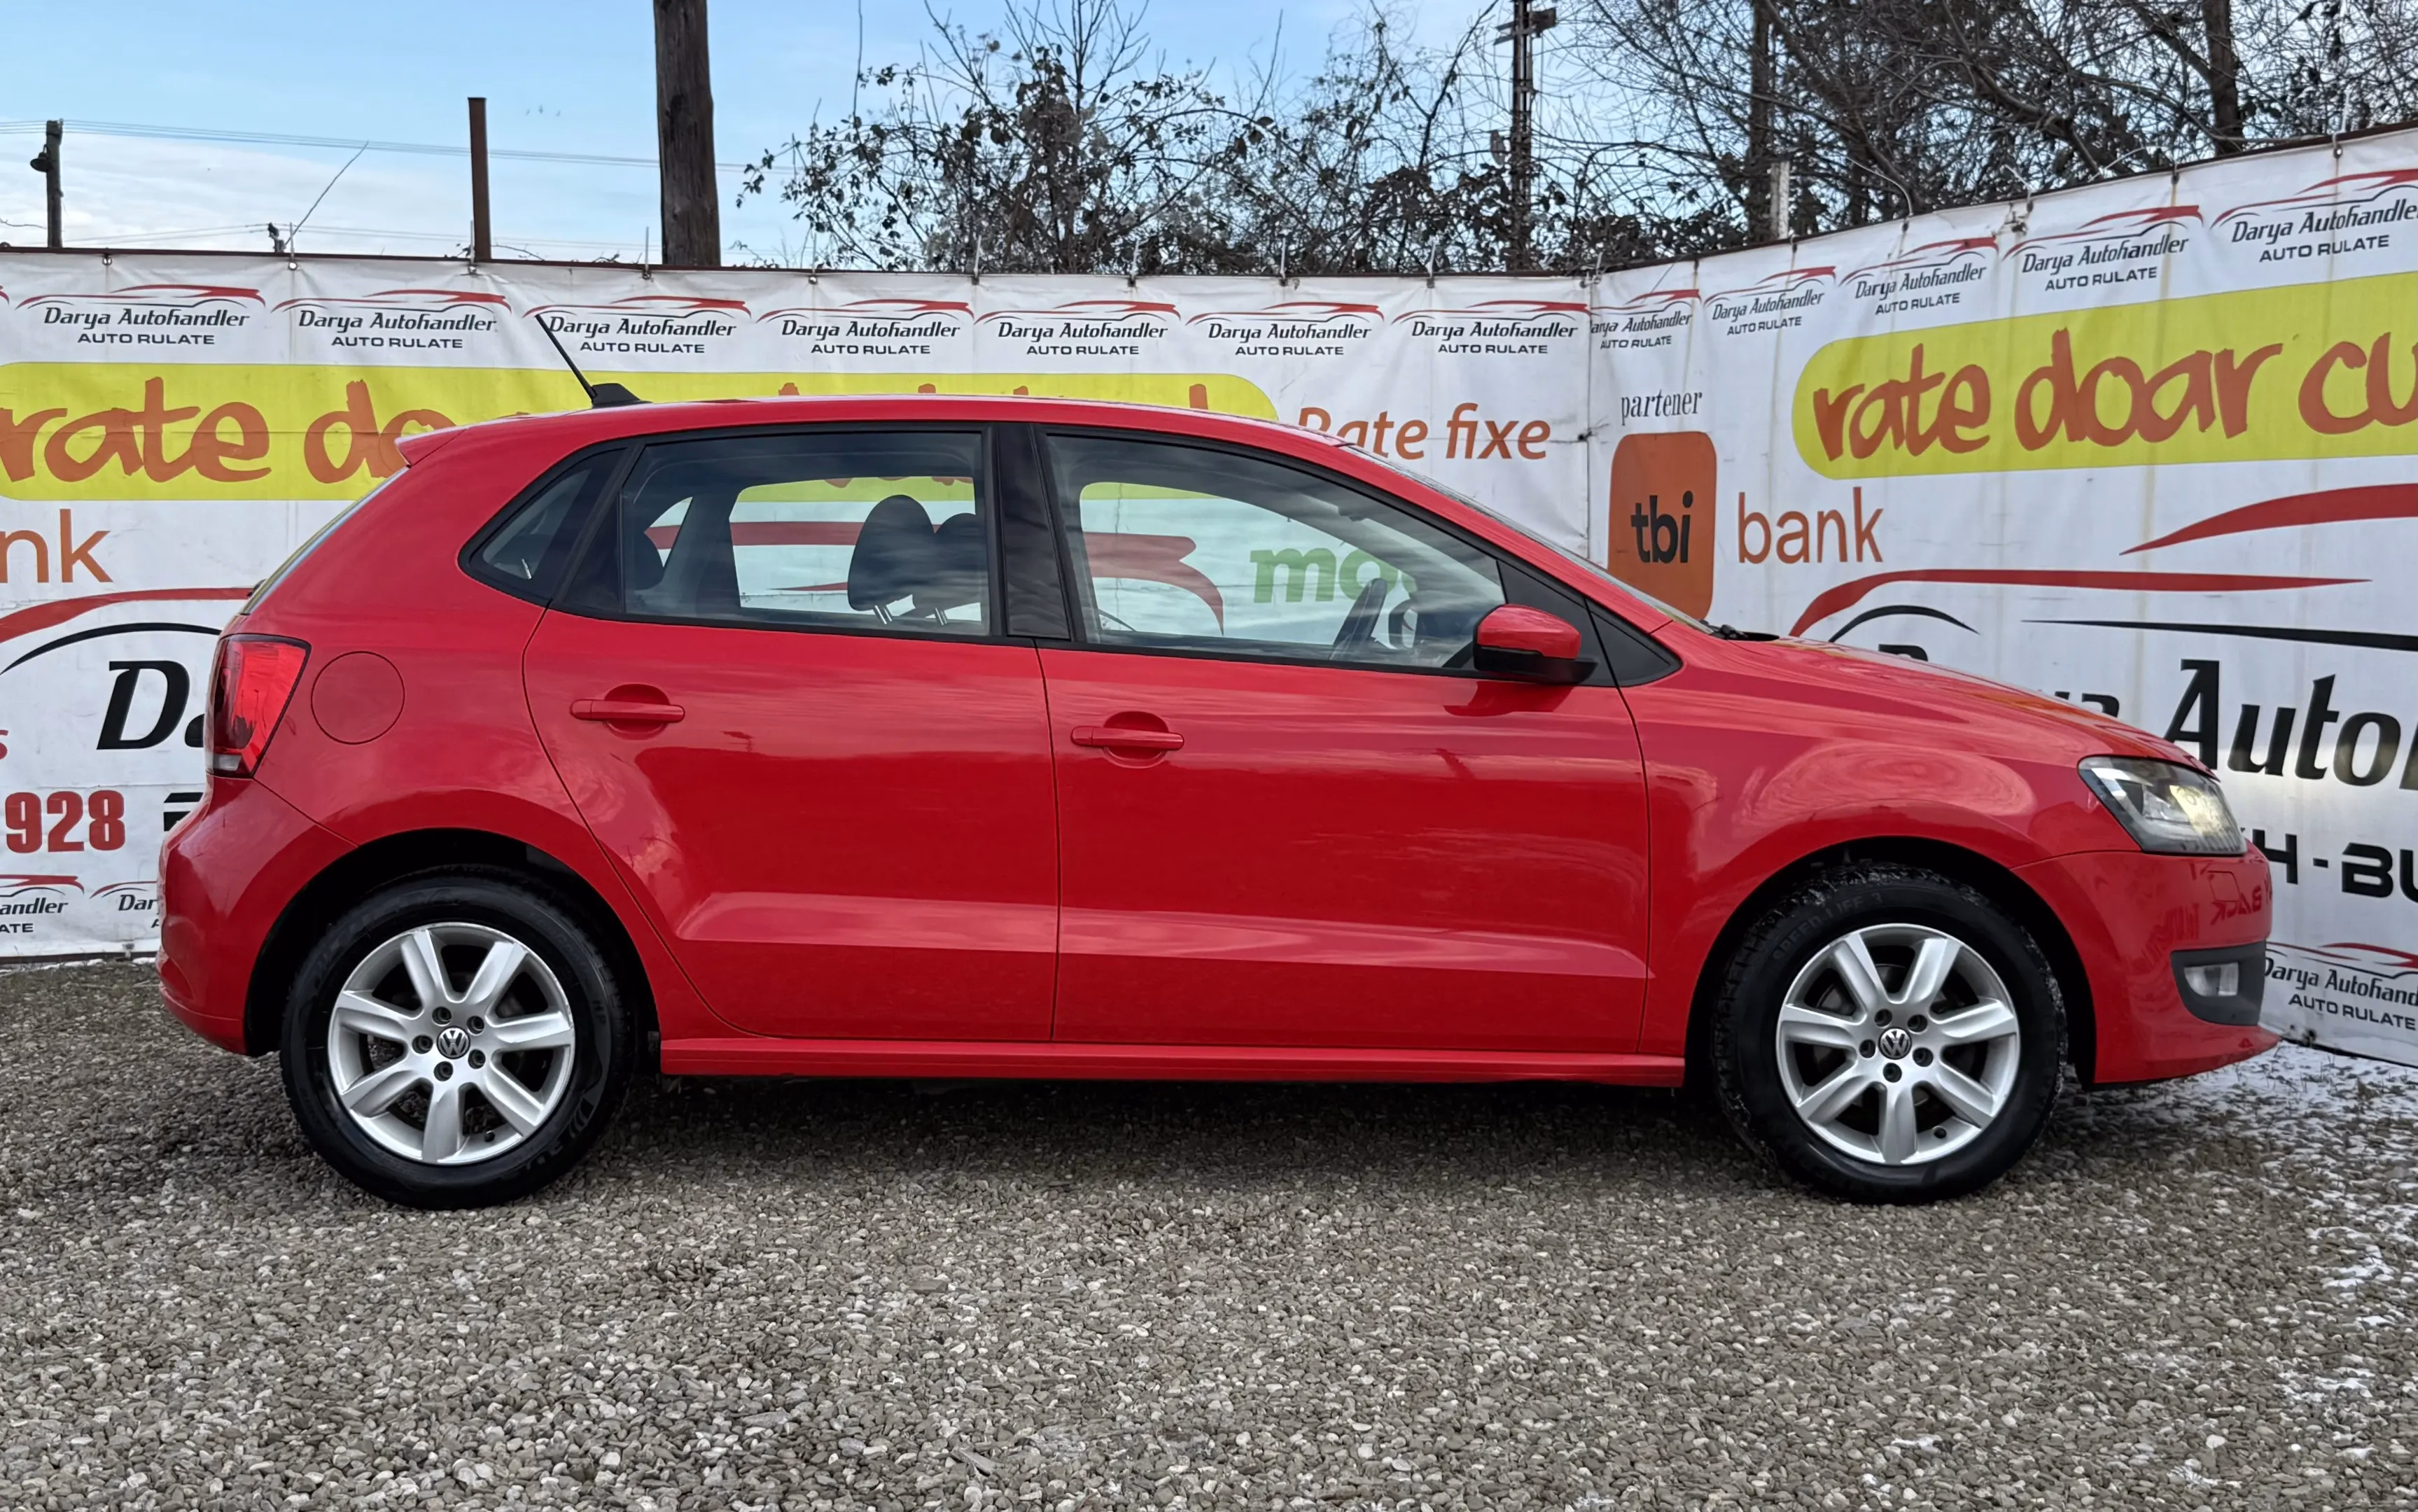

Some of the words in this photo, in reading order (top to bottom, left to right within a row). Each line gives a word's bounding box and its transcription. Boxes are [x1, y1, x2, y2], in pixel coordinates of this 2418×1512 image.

[2232, 221, 2293, 245] Darya
[2298, 199, 2418, 234] Autohandle
[2022, 252, 2074, 276] Darya
[2078, 235, 2189, 265] Autohandler
[2260, 245, 2312, 262] AUTO
[2318, 235, 2389, 255] RULATE
[1855, 277, 1897, 301] Darya
[1900, 263, 1986, 291] Autohandler
[2046, 276, 2088, 290] AUTO
[2092, 267, 2157, 285] RULATE
[1712, 304, 1747, 322] Darya
[1749, 289, 1824, 314] Autohandler
[1875, 300, 1908, 315] AUTO
[1911, 293, 1960, 309] RULATE
[44, 307, 111, 330] Darya
[118, 309, 249, 326] Autohandler
[299, 310, 363, 333] Darya
[370, 313, 497, 330] Autohandler
[550, 316, 610, 339] Darya
[617, 318, 736, 335] Autohandler
[782, 320, 839, 340] Darya
[846, 321, 960, 337] Autohandler
[1590, 318, 1619, 337] arya
[1622, 311, 1693, 332] Autohandler
[1727, 323, 1756, 335] AUTO
[1758, 316, 1801, 330] RULATE
[78, 334, 132, 343] AUTO
[138, 335, 214, 344] RULATE
[332, 337, 384, 346] AUTO
[389, 338, 462, 348] RULATE
[998, 322, 1054, 342] Darya
[1060, 323, 1168, 337] Autohandler
[1209, 323, 1261, 343] Darya
[1267, 324, 1371, 338] Autohandler
[1412, 321, 1465, 341] Darya
[1470, 322, 1578, 337] Autohandler
[1600, 340, 1628, 349] AUTO
[1631, 335, 1671, 347] RULATE
[580, 342, 629, 351] AUTO
[635, 344, 704, 353] RULATE
[811, 344, 858, 354] AUTO
[863, 346, 930, 354] RULATE
[1027, 346, 1072, 354] AUTO
[1076, 346, 1139, 354] RULATE
[1236, 346, 1279, 355] AUTO
[1283, 346, 1343, 355] RULATE
[1439, 344, 1480, 354] AUTO
[1484, 344, 1548, 354] RULATE
[1813, 343, 1990, 462] rate
[2015, 327, 2283, 451] doar
[1621, 391, 1702, 426] partener
[0, 377, 272, 482] rate
[1446, 402, 1551, 460] fixe
[1630, 491, 1693, 564] tbi
[1738, 486, 1884, 564] bank
[5, 790, 126, 854] 928
[2288, 994, 2338, 1014] AUTO
[2343, 1004, 2415, 1030] RULATE
